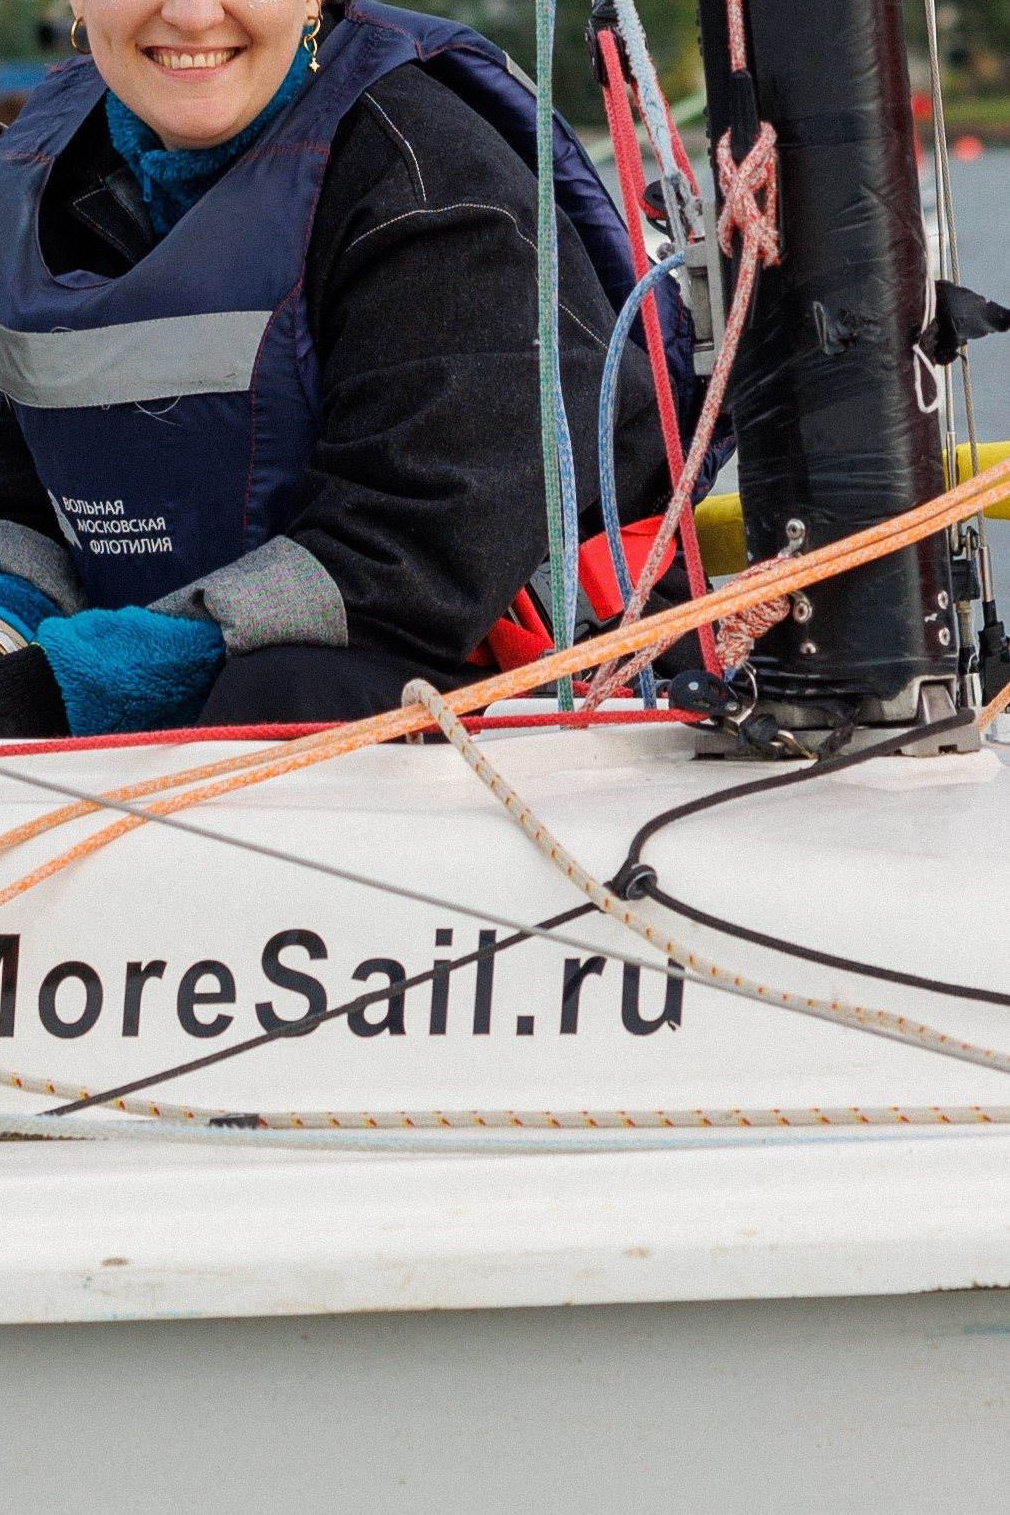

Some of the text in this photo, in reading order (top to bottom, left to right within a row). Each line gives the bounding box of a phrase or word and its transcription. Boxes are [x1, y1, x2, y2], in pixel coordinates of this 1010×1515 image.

[62, 496, 125, 515] ВОЛЬНАЯ
[76, 516, 167, 534] МОСКОВСКАЯ
[90, 536, 173, 555] ФЛОТИЛИЯ
